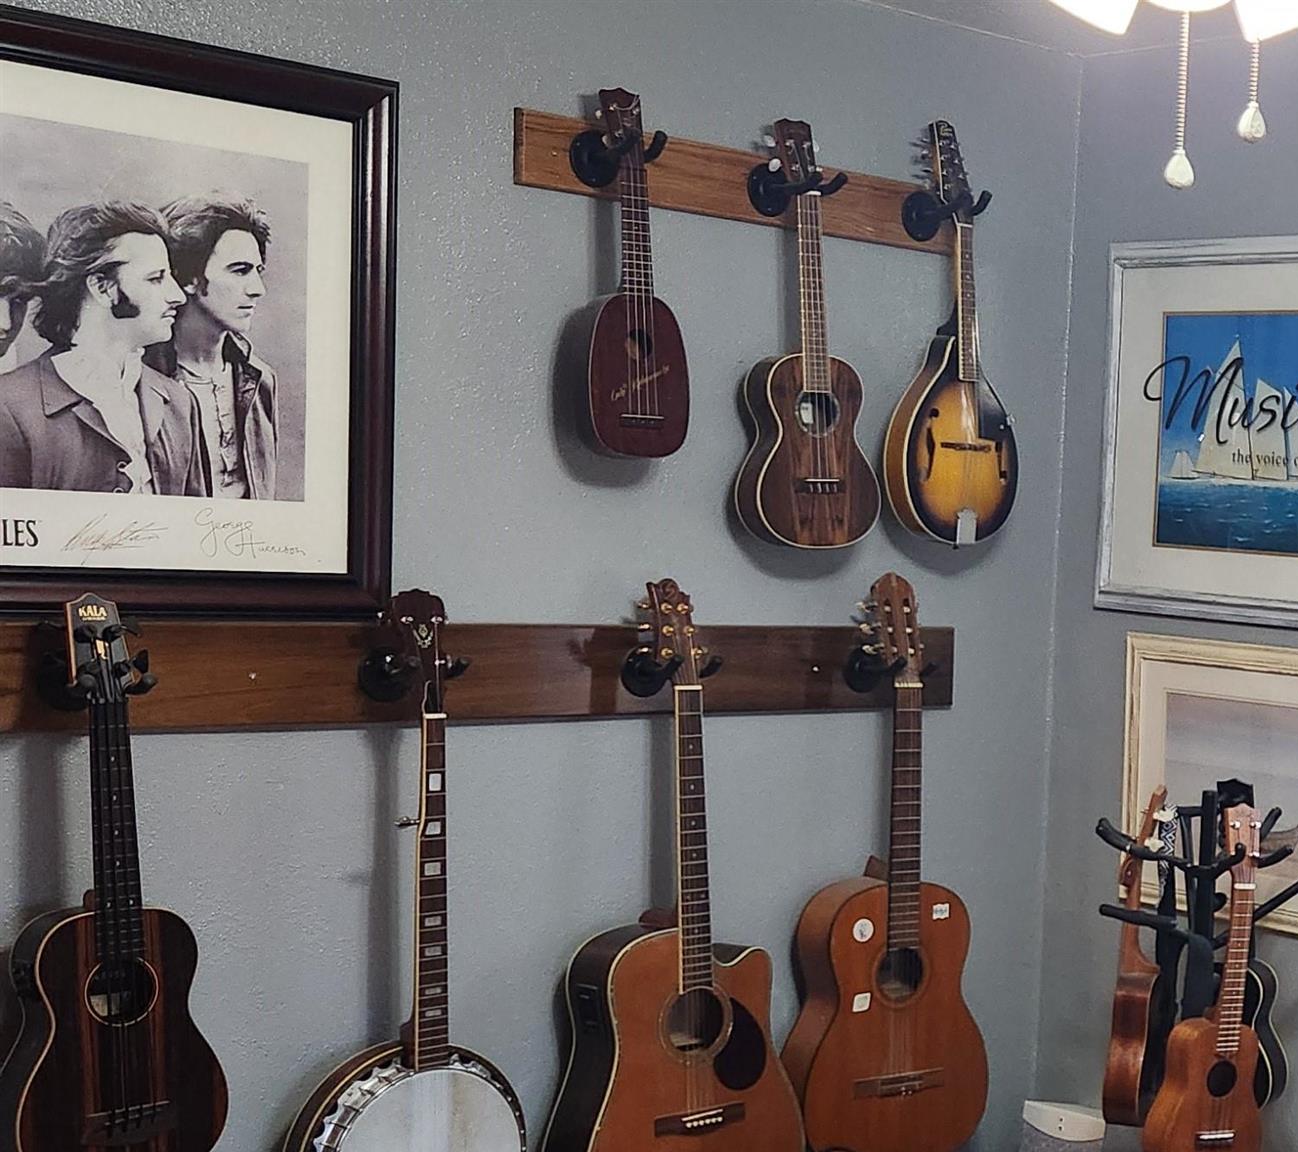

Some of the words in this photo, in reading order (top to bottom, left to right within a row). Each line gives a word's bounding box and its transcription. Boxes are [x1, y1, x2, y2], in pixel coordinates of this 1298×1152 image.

[1231, 448, 1251, 464] the
[1256, 451, 1289, 466] voice
[78, 605, 107, 617] KALA
